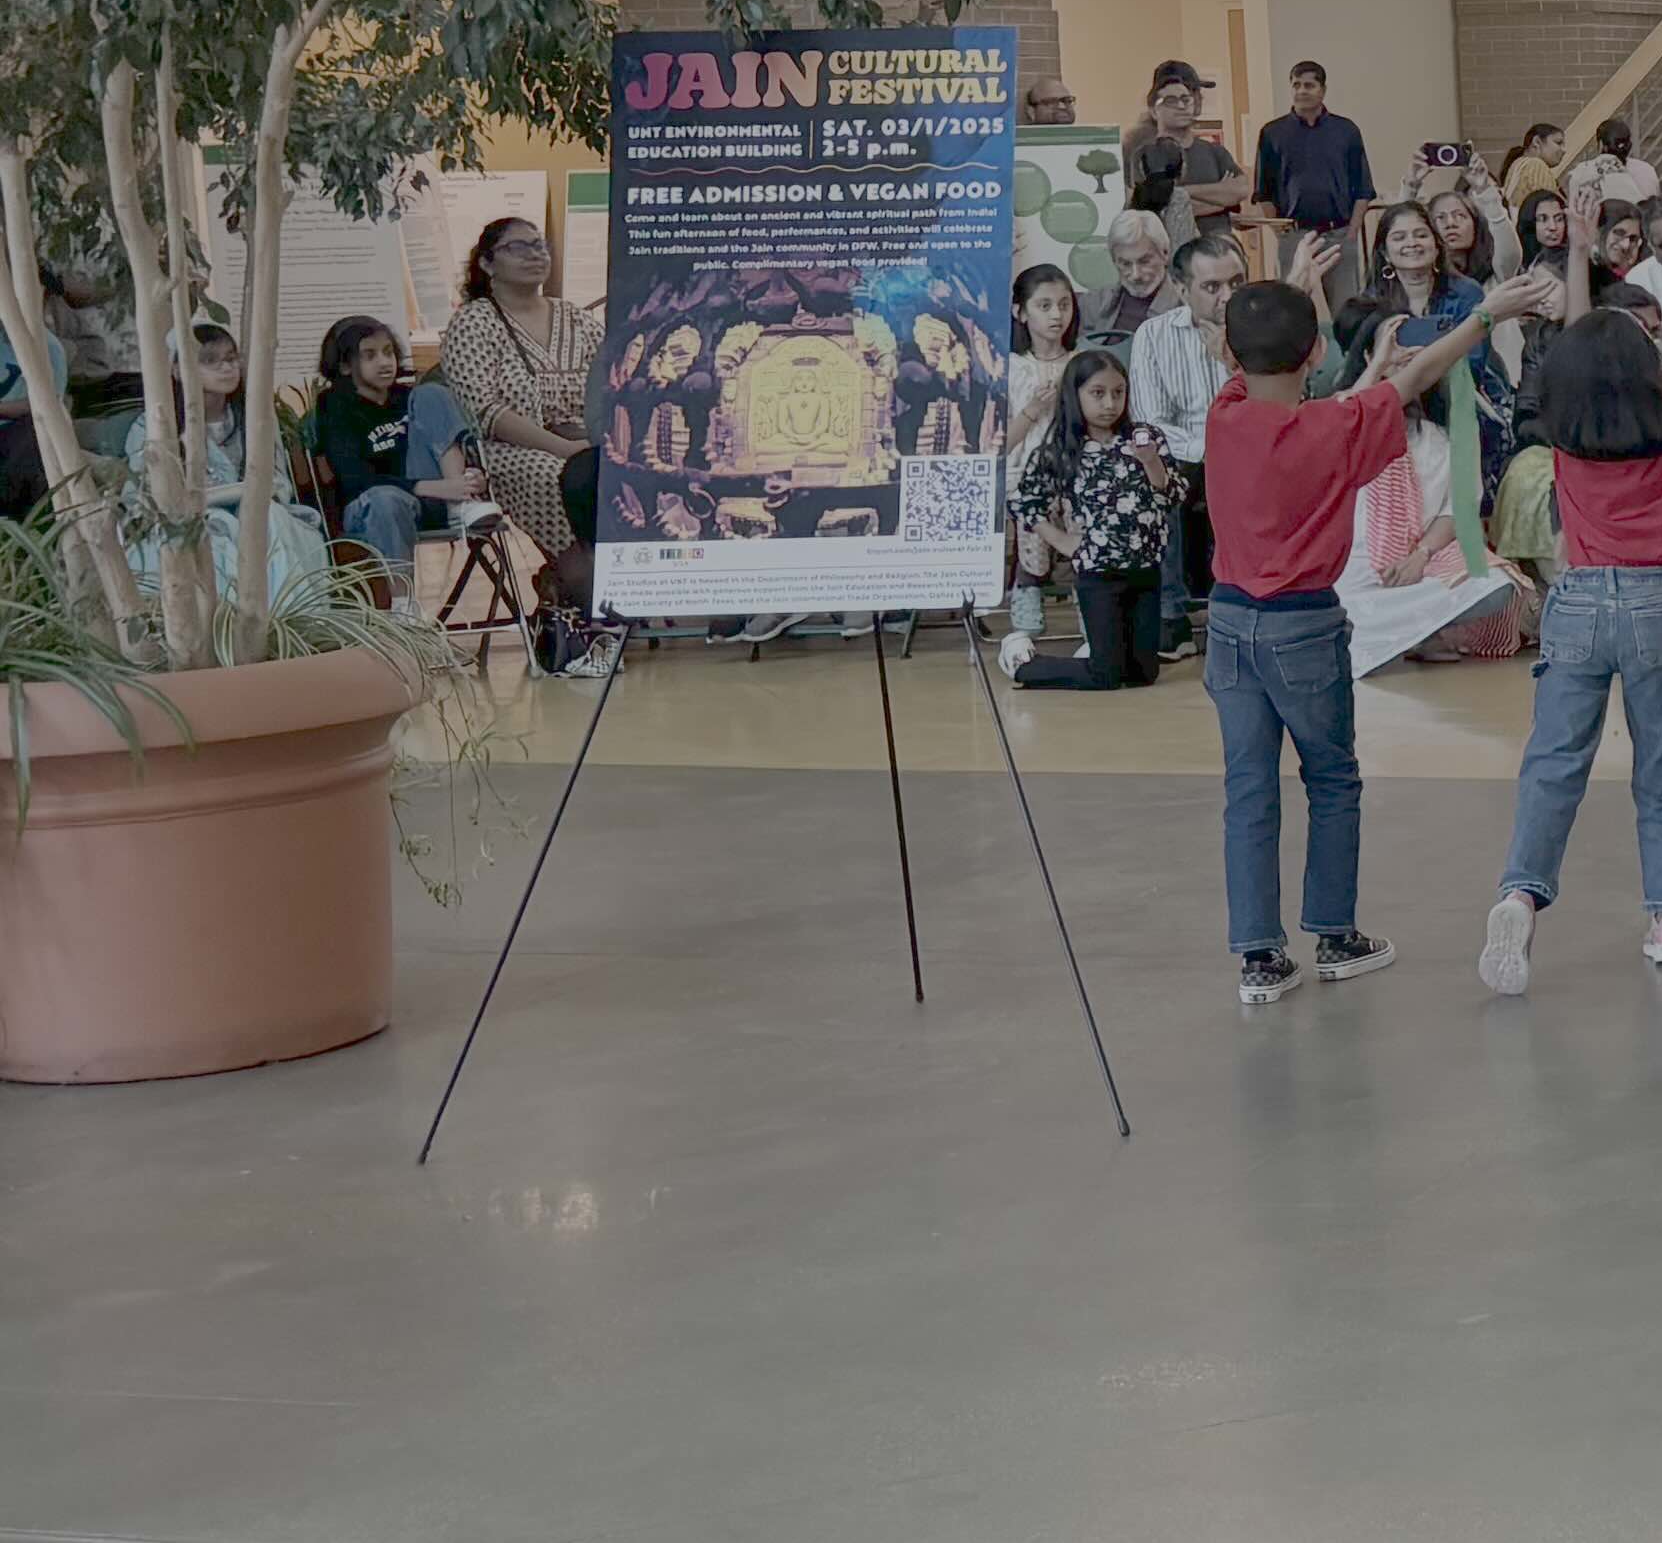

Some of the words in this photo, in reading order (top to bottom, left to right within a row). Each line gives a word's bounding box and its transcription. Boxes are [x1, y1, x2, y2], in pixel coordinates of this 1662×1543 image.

[828, 48, 1007, 75] CULTURAL
[624, 50, 822, 110] JAIN
[827, 77, 1007, 105] FESTIVAL
[628, 126, 661, 139] UNT
[665, 124, 801, 139] ENVIRONMENTAL
[822, 119, 873, 137] SAT.
[881, 117, 1005, 137] 03/1/2025
[627, 144, 722, 159] EDUCATION
[725, 142, 802, 157] BUILDING
[822, 139, 859, 156] 2-5
[867, 140, 917, 159] p.m.
[627, 186, 683, 205] FREE
[688, 184, 822, 204] ADMISSION
[829, 184, 844, 202] &
[850, 183, 929, 201] VEGAN
[935, 181, 1002, 200] FOOD
[624, 214, 656, 223] Come
[657, 213, 679, 223] and
[682, 212, 709, 223] learn
[711, 212, 742, 221] about
[760, 211, 801, 221] ancient
[803, 210, 823, 219] and
[825, 209, 864, 219] vibrant
[866, 208, 910, 221] spiritual
[912, 208, 937, 219] path
[938, 208, 965, 218] from
[628, 229, 651, 239] This
[652, 229, 671, 238] fun
[673, 229, 726, 238] afternoon
[728, 228, 741, 237] of
[741, 227, 769, 238] food,
[849, 226, 870, 235] and
[872, 224, 920, 235] activities
[921, 224, 942, 234] will
[943, 223, 993, 234] celebrate
[628, 245, 651, 255] Jain
[653, 244, 706, 255] traditions
[708, 244, 728, 254] and
[731, 244, 749, 253] the
[751, 243, 774, 254] Jain
[776, 242, 837, 255] community
[838, 242, 850, 252] in
[851, 241, 881, 252] DFW.
[882, 242, 906, 251] Free
[908, 241, 928, 250] and
[931, 241, 958, 252] open
[960, 240, 972, 250] to
[974, 240, 992, 249] the
[693, 260, 730, 273] public.
[732, 258, 814, 271] Complimentary
[816, 259, 849, 269] vegan
[850, 257, 876, 267] food
[877, 256, 928, 269] provided!
